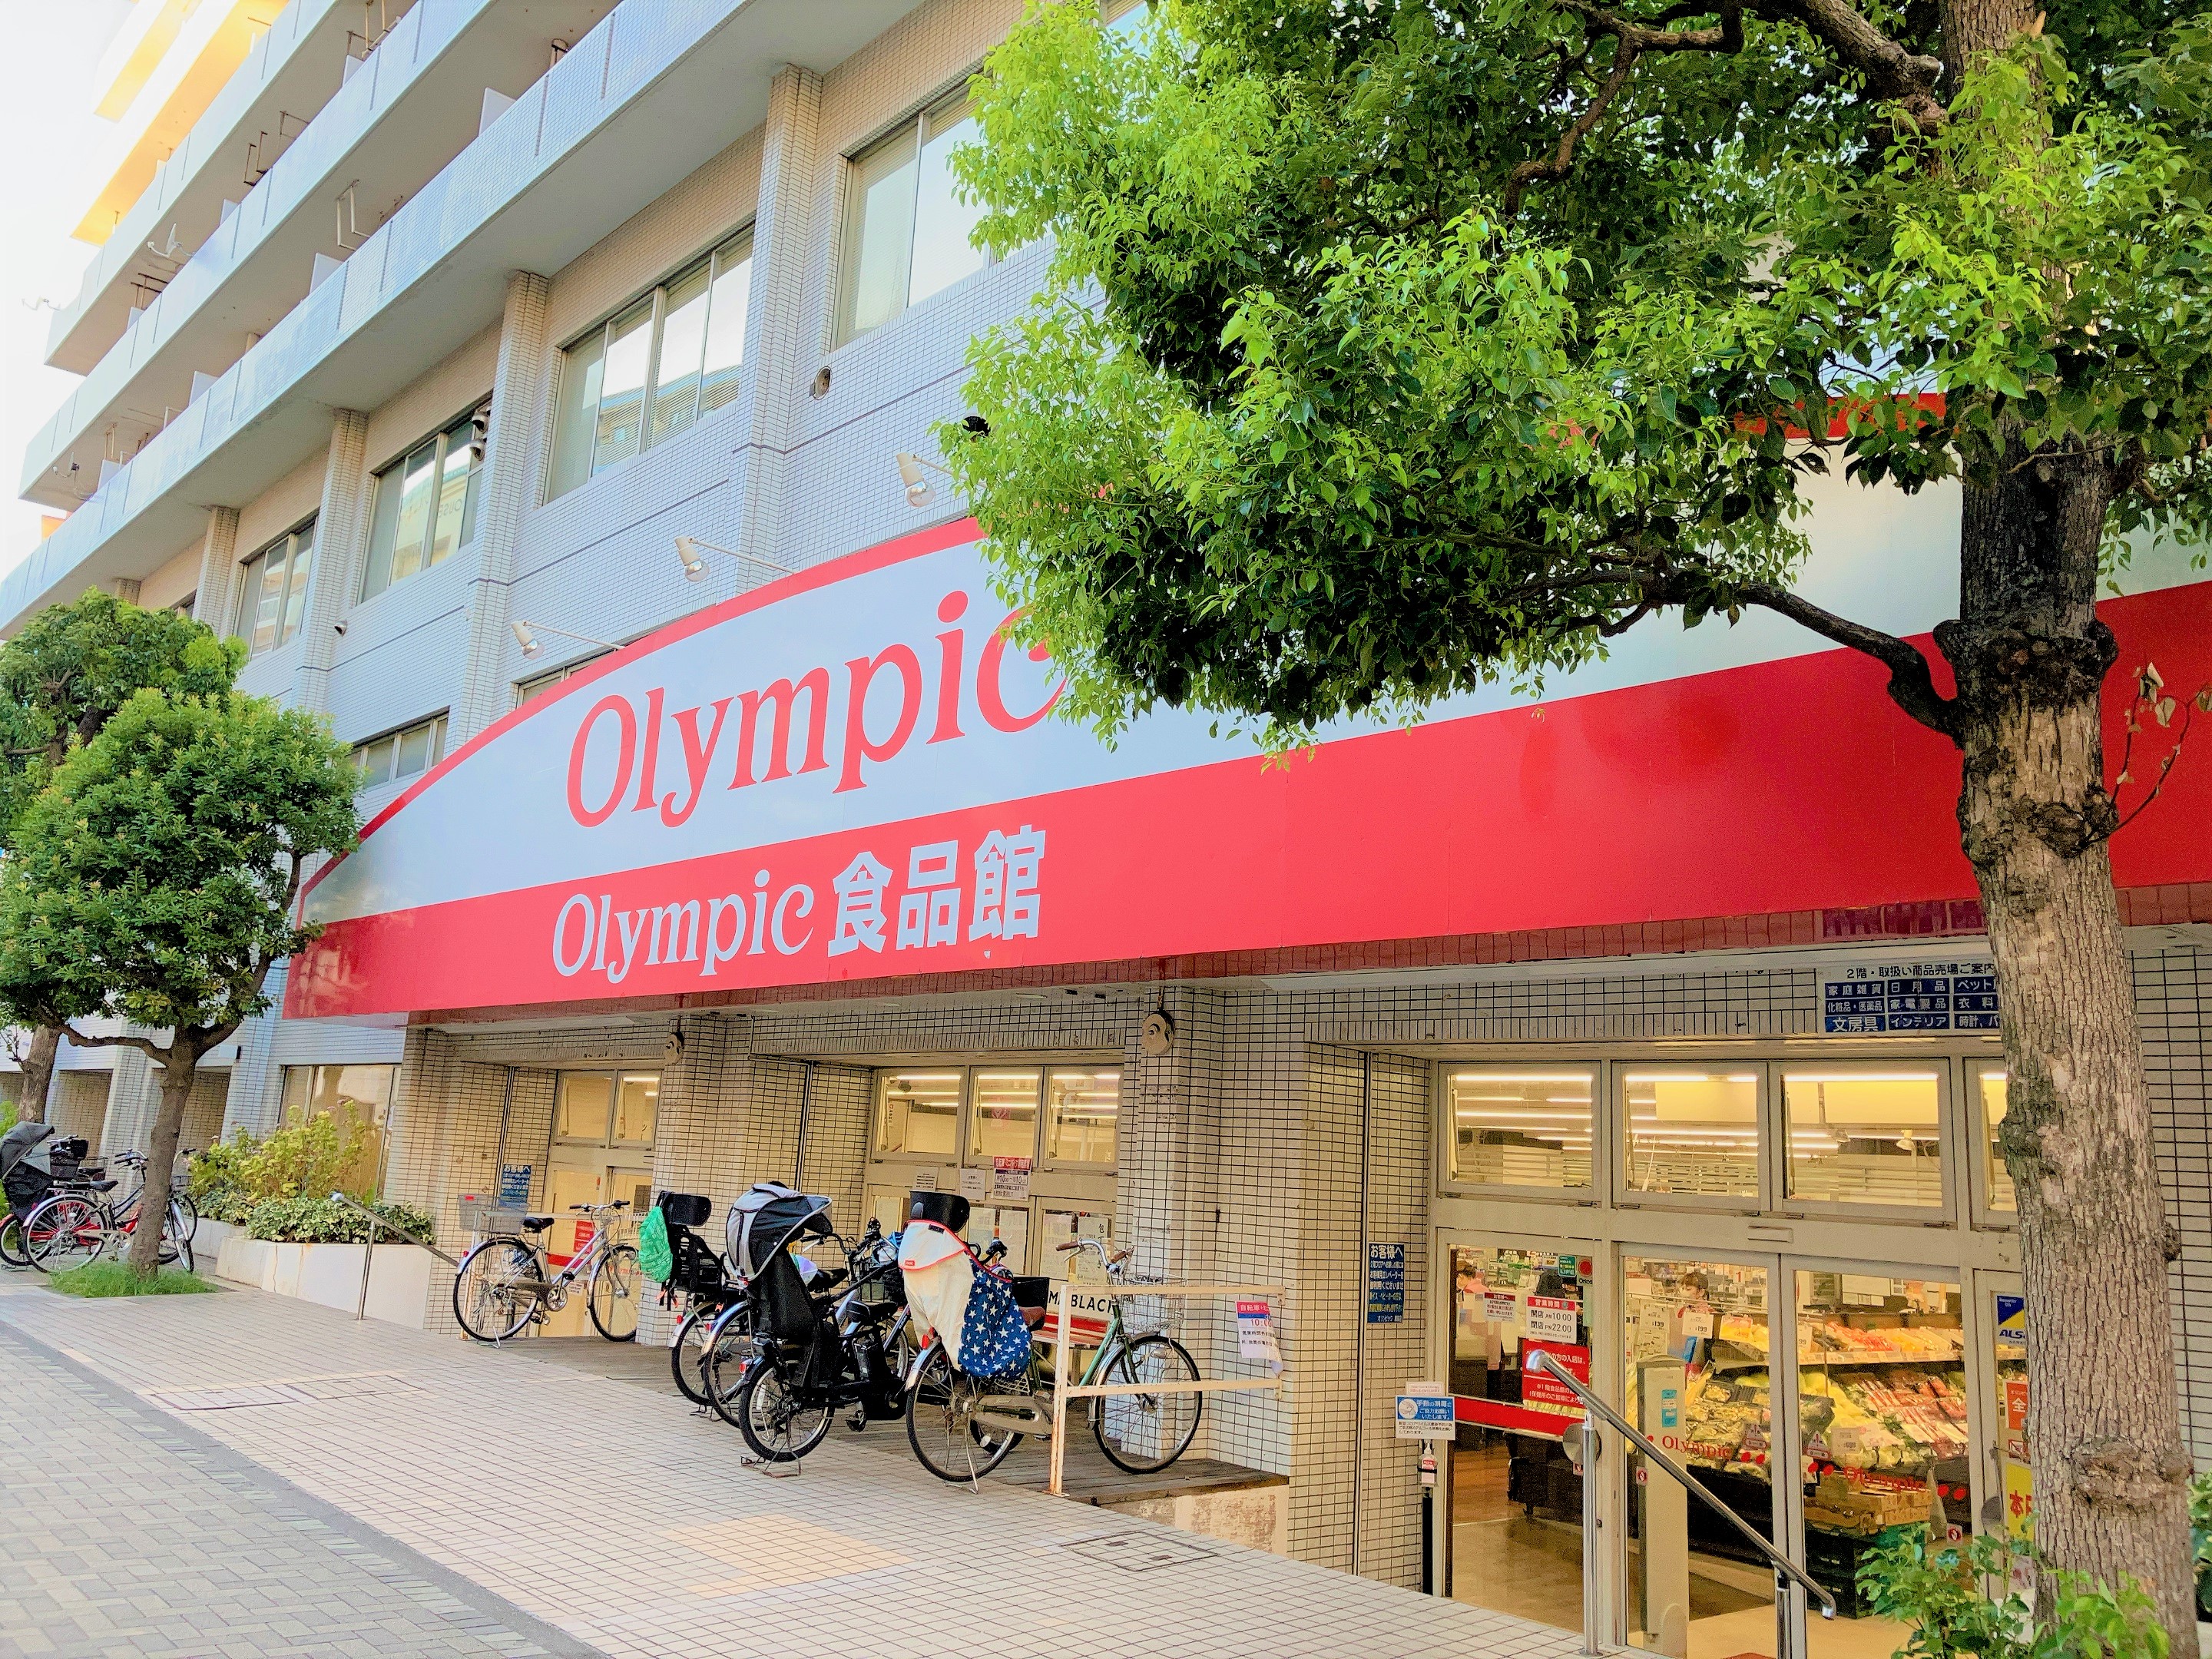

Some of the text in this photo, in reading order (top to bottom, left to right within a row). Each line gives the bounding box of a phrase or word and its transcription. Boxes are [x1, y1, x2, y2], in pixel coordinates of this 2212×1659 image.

[567, 591, 1067, 828] Olympic
[552, 825, 1046, 984] Olympic 食品館
[1828, 984, 1882, 996] 家庭雑貨
[1891, 980, 1945, 993] 日用品
[1890, 997, 1946, 1010] 家電製品
[1833, 1016, 1879, 1032] 文房具
[1891, 1015, 1946, 1028] インテリア
[1370, 1244, 1403, 1259] お客様へ
[1531, 1310, 1544, 1319] 開店
[1531, 1321, 1544, 1330] 閉店
[1999, 1329, 2025, 1339] ALS
